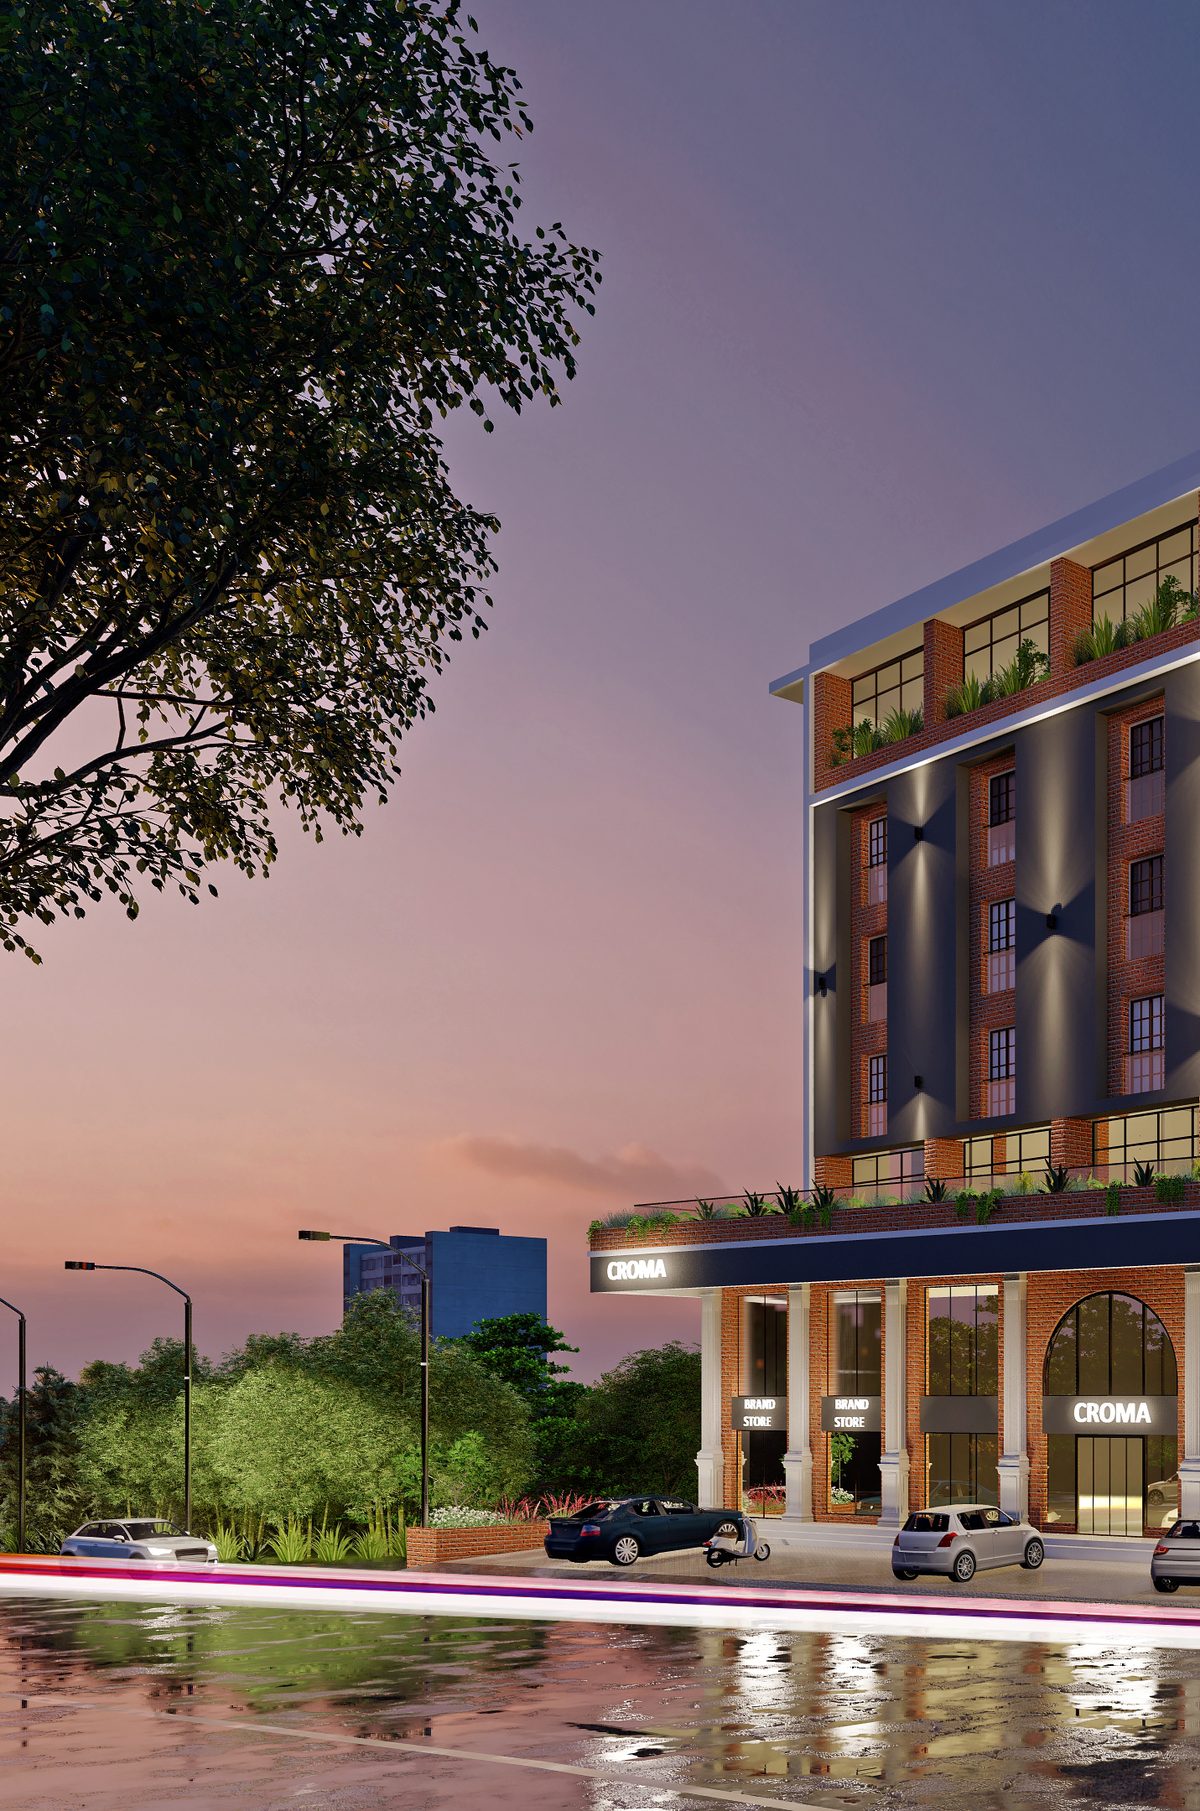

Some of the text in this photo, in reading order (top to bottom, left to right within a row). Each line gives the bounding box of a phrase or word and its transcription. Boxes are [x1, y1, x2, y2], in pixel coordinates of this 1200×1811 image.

[606, 1258, 667, 1280] CROMA
[743, 1398, 776, 1410] BRAND
[834, 1398, 869, 1410] BRAND
[1073, 1402, 1152, 1424] CROMA
[742, 1416, 772, 1427] STORE
[834, 1416, 865, 1428] STORE
